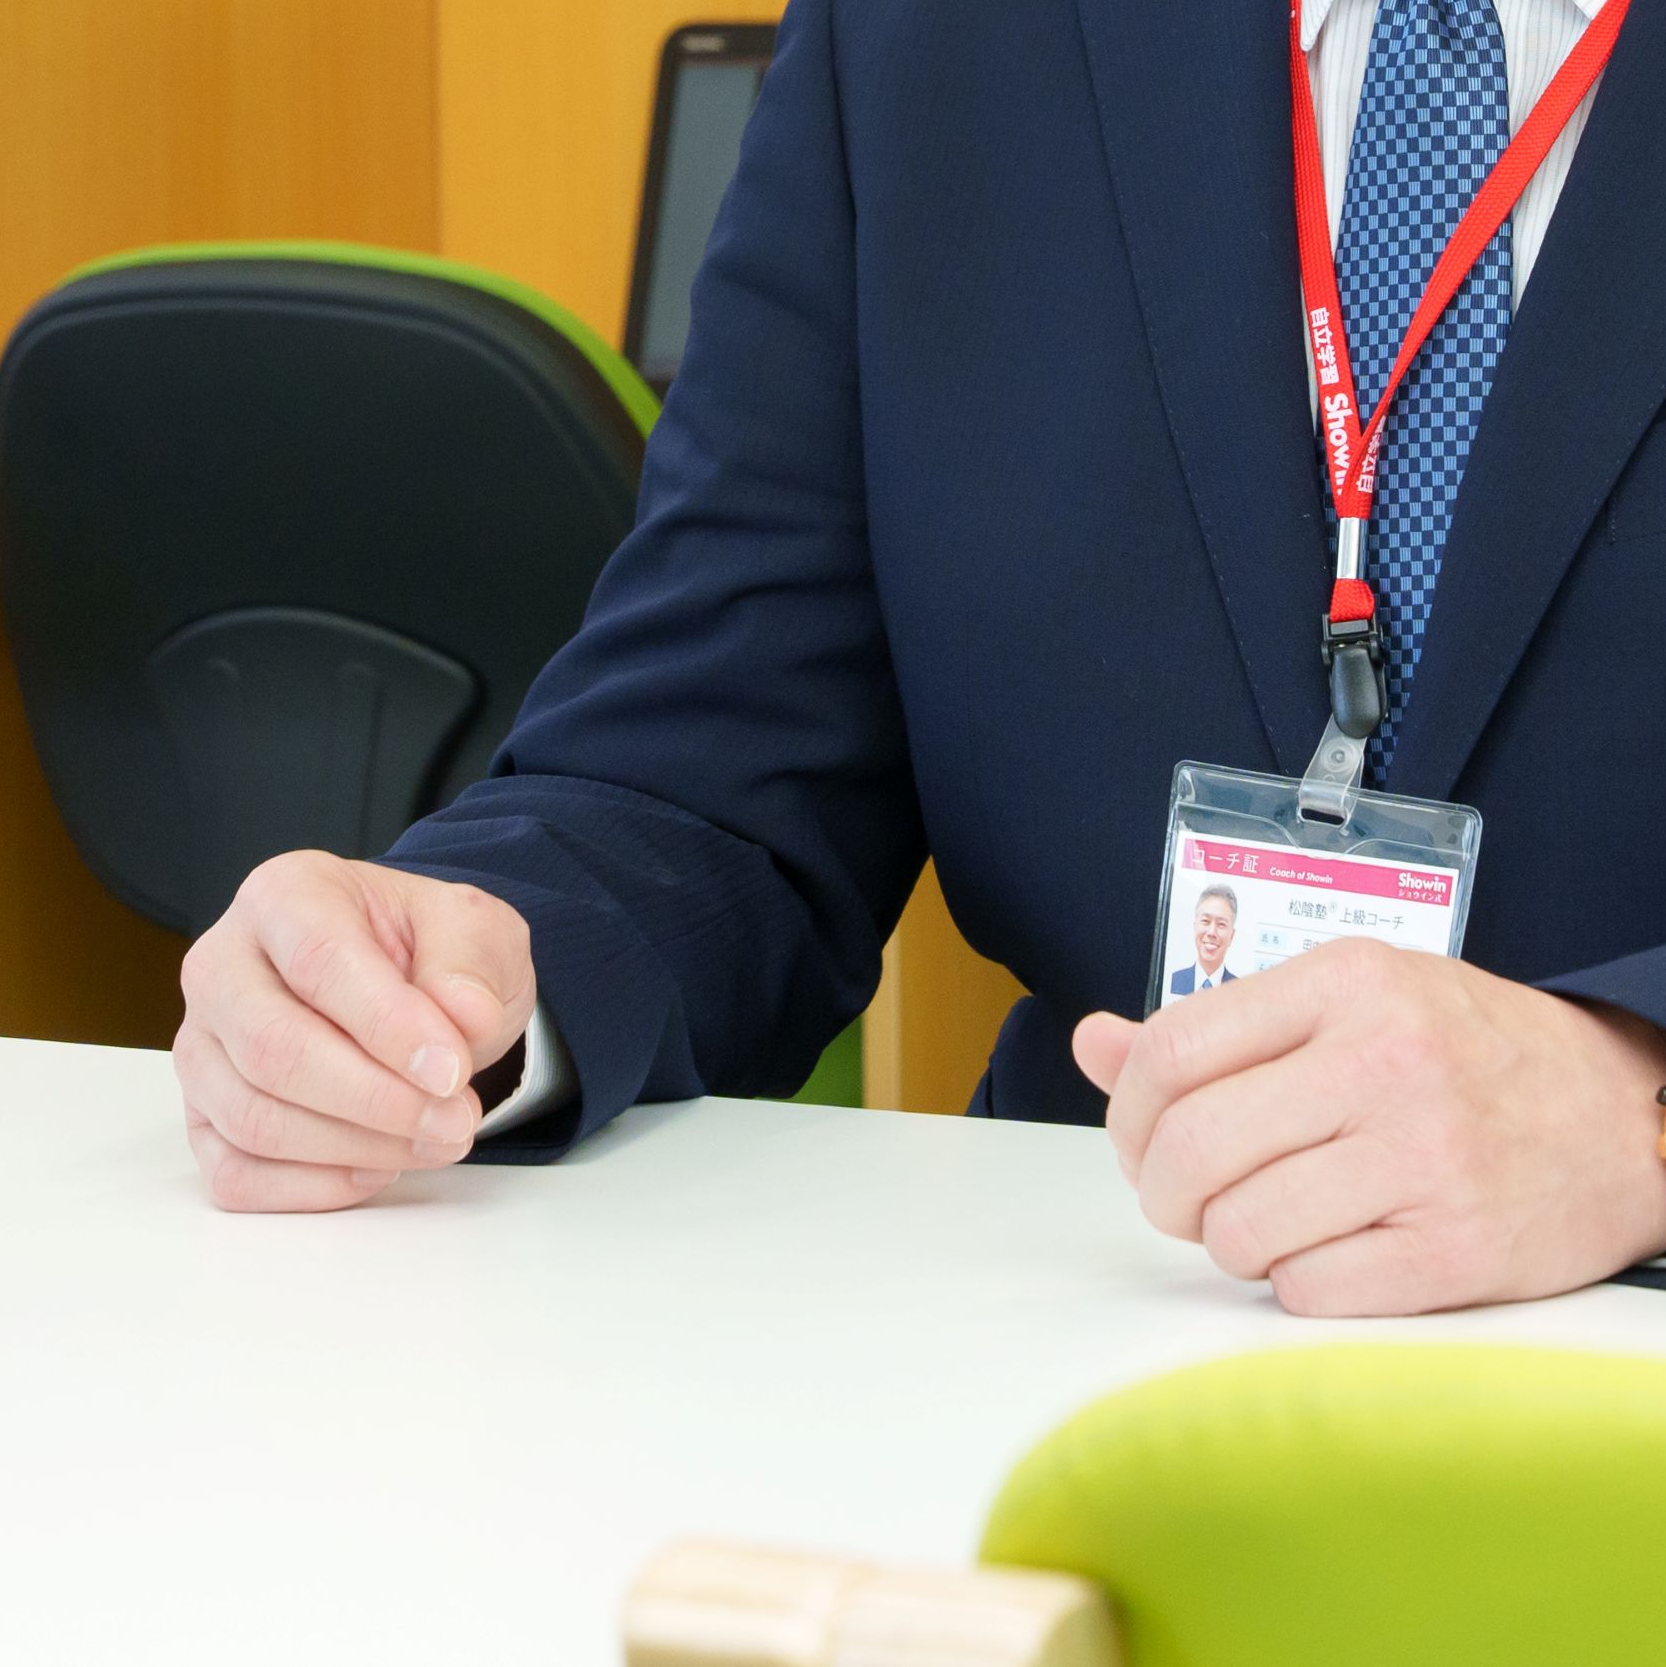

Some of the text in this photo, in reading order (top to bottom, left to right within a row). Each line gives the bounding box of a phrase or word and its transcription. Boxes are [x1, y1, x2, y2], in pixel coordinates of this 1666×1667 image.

[1192, 848, 1259, 874] コーチ証
[1270, 867, 1334, 884] Coach of Showin
[1398, 872, 1447, 893] Showin
[1339, 908, 1404, 930] 上級コーチ
